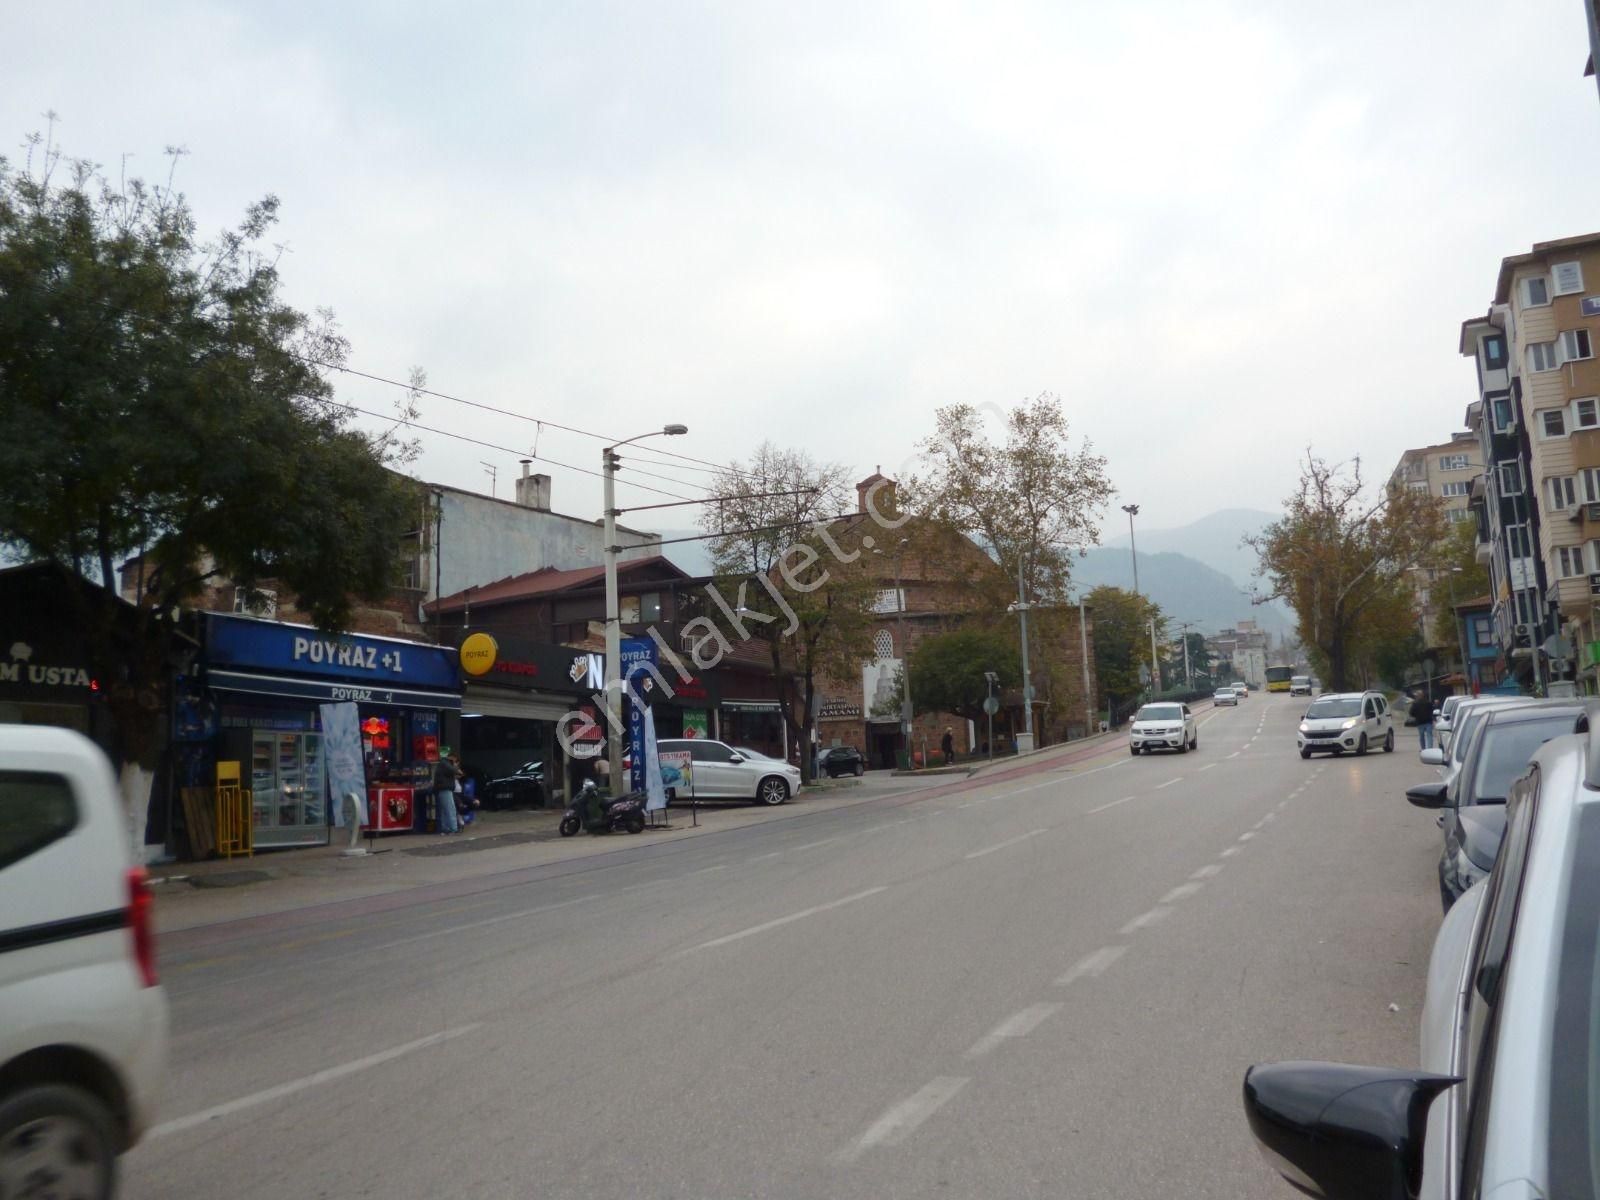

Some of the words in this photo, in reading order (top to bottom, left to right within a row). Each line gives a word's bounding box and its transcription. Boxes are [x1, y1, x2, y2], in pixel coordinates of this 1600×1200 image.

[294, 636, 377, 670] POYRAZ
[381, 650, 403, 673] +1
[465, 650, 489, 659] POYRAZ
[620, 649, 652, 662] OYRAZ
[0, 662, 19, 682] M
[27, 664, 90, 686] USTA
[331, 687, 372, 701] POYRAZ
[631, 697, 641, 780] POYRAZ
